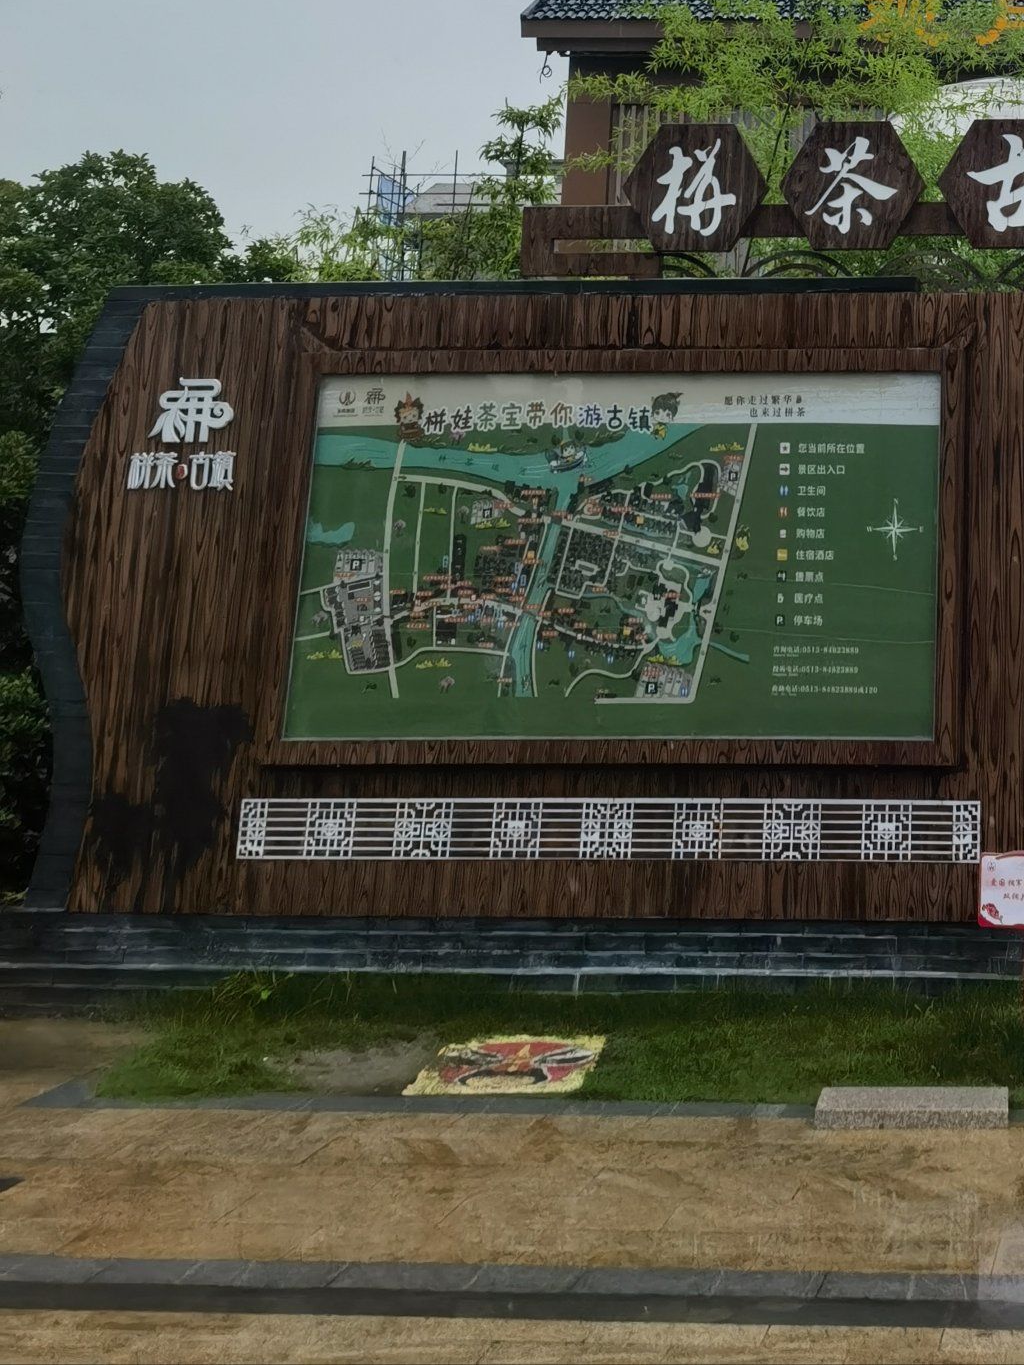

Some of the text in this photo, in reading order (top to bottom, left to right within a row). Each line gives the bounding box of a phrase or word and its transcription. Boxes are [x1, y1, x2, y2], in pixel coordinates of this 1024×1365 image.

[798, 443, 865, 454] 您当前所在位置
[798, 465, 845, 475] 景区出入口
[797, 486, 826, 496] 卫生间
[797, 507, 825, 518] 餐饮店
[796, 528, 825, 539] 购物店
[796, 550, 834, 561] 住宿酒店
[795, 572, 824, 582] 售票点
[794, 593, 824, 604] 医疗点
[793, 615, 823, 626] 停车场
